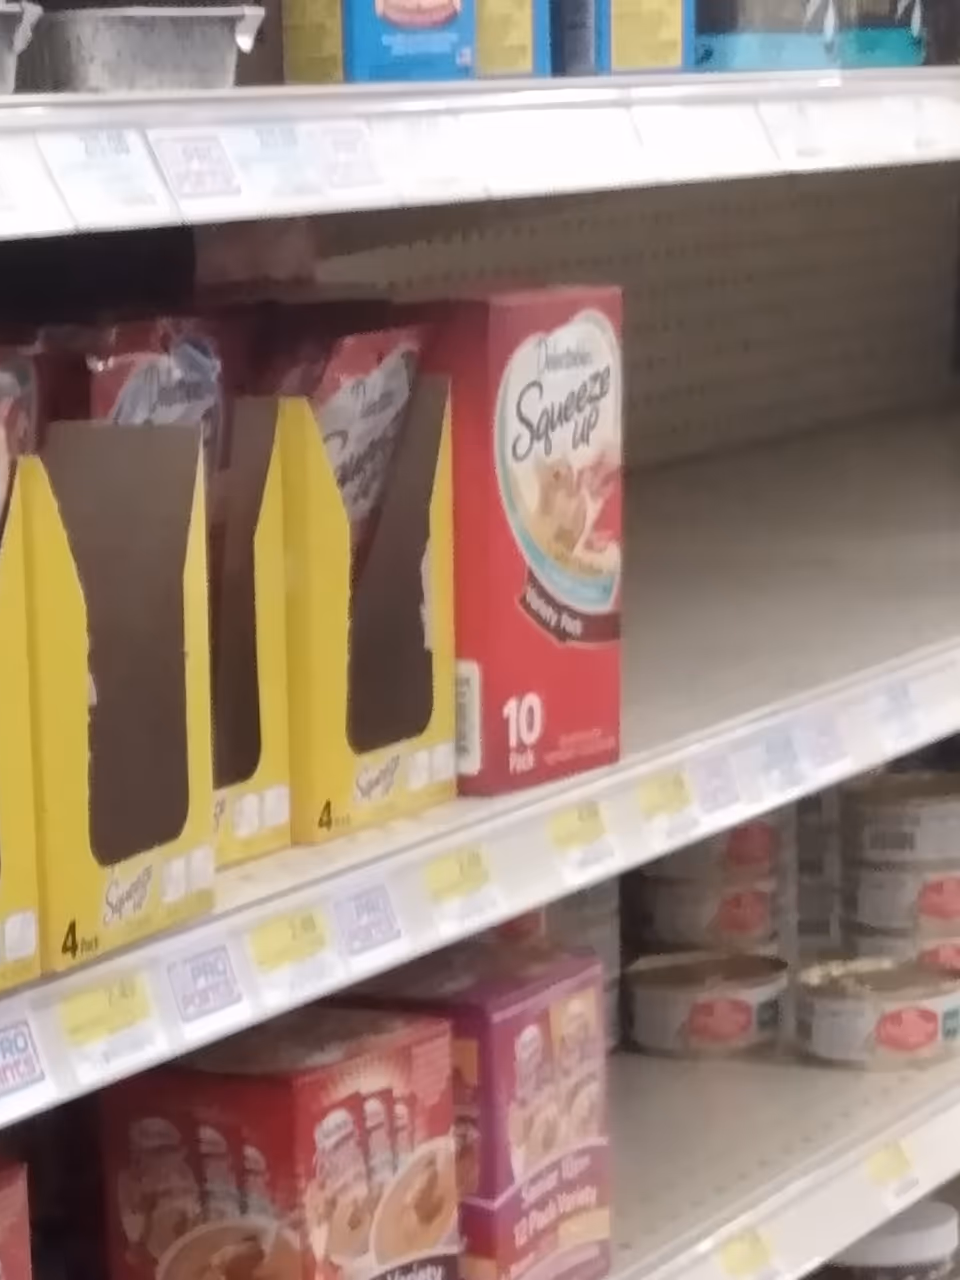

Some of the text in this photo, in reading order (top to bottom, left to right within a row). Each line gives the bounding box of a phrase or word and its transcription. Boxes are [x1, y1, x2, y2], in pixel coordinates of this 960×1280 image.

[512, 365, 611, 465] Squeeze
[502, 691, 543, 748] 10
[318, 798, 333, 832] 4
[61, 917, 78, 960] 4
